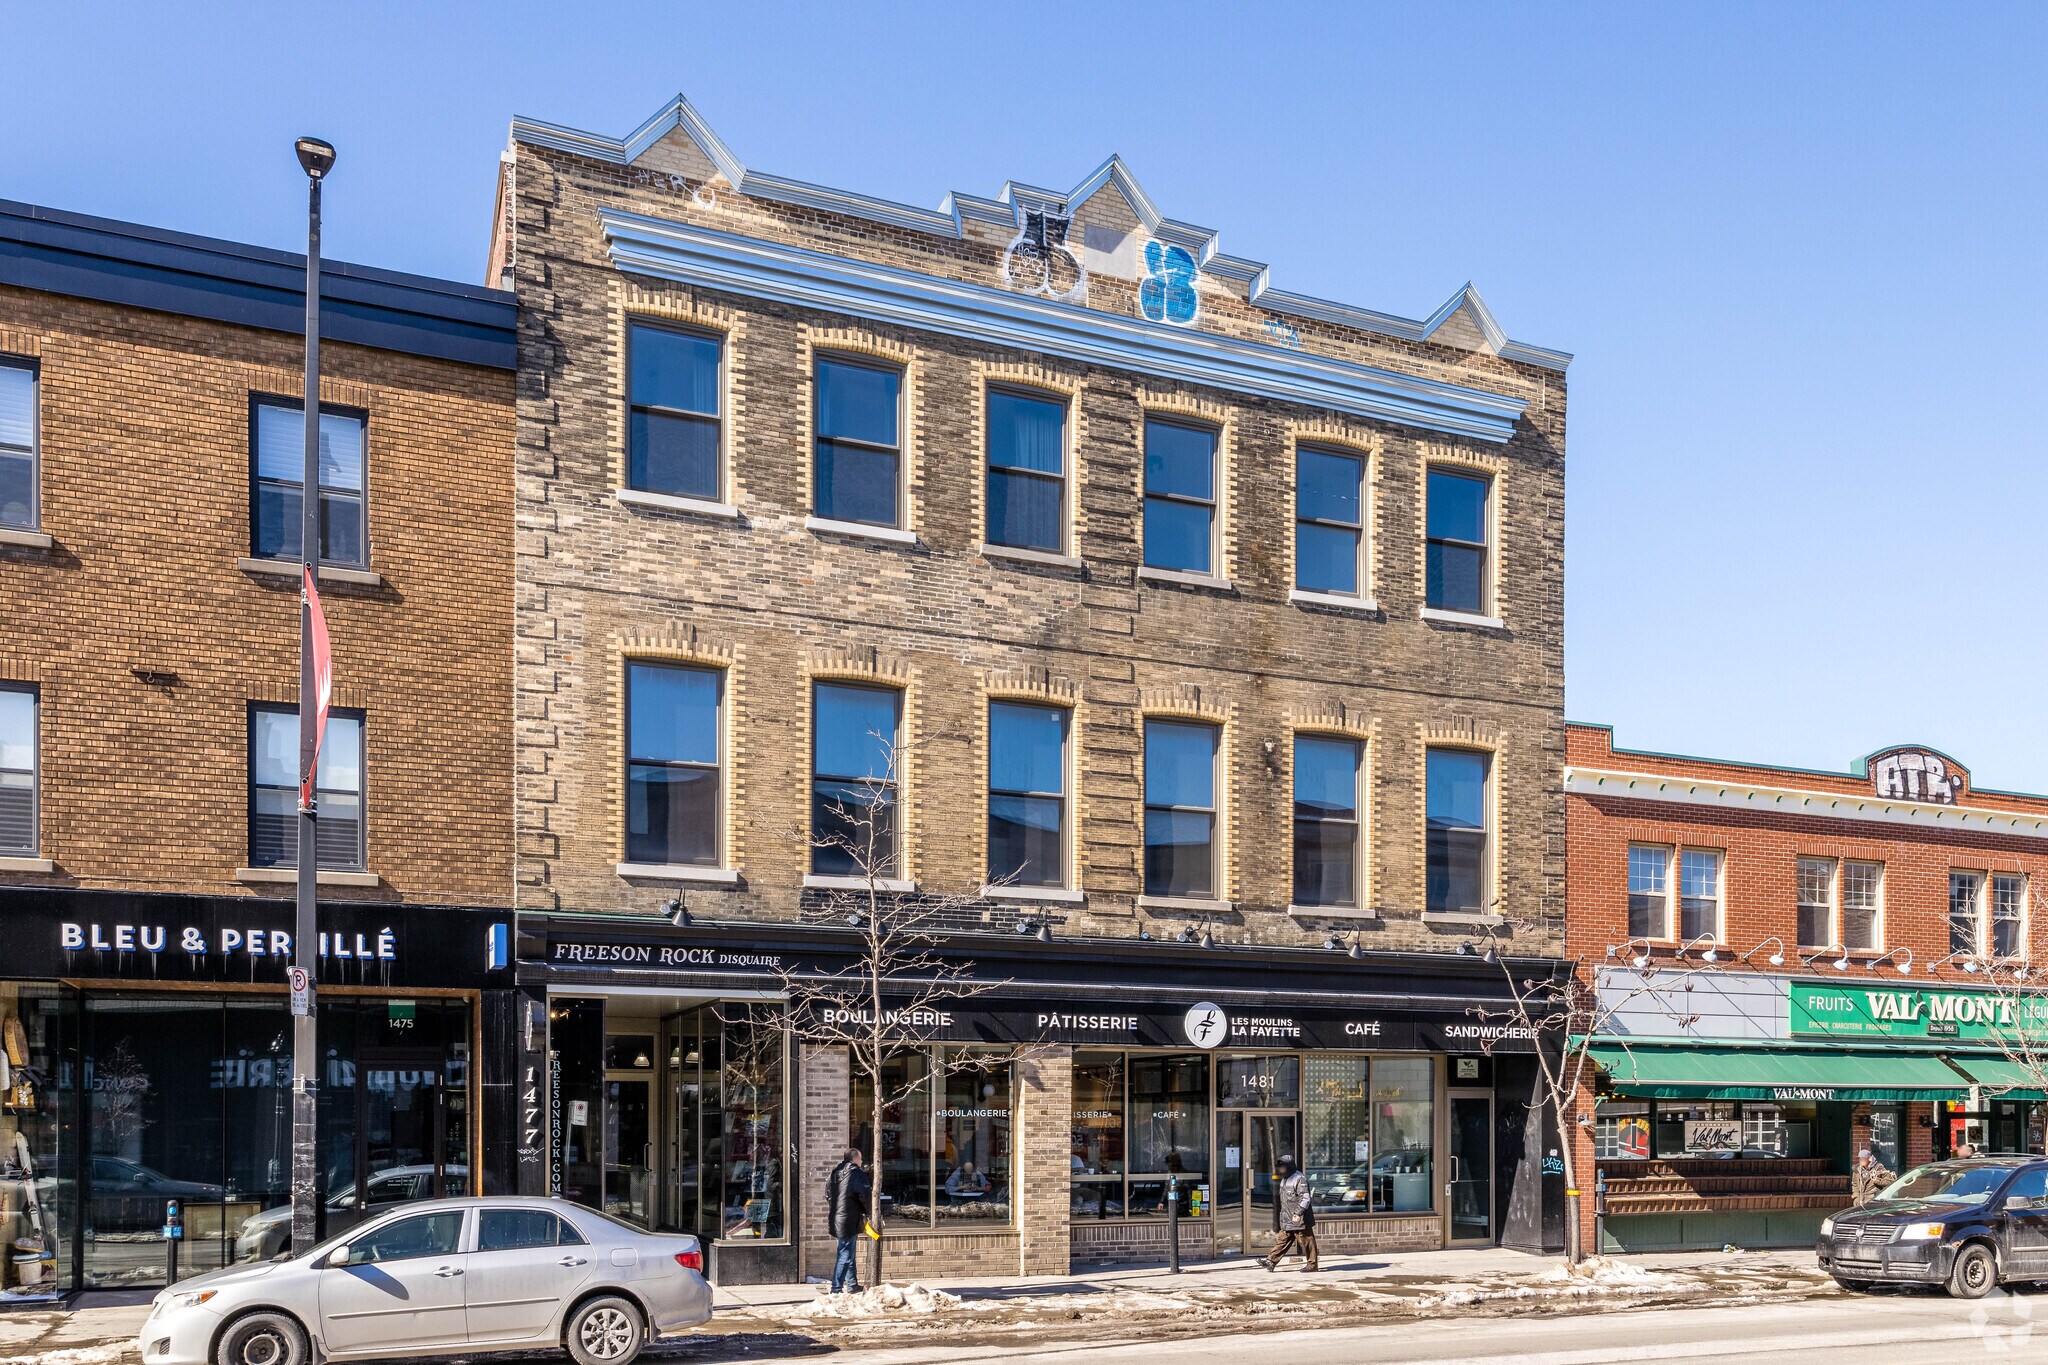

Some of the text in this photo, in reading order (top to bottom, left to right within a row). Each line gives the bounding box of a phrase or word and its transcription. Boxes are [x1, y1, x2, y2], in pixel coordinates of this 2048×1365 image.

[61, 923, 397, 960] BLEU & PERILLÉ
[555, 943, 781, 967] FREESON ROCK DISQUAIRE
[1808, 995, 1854, 1012] FRUITS
[1929, 995, 2017, 1024] MONT
[389, 1018, 414, 1029] 1475
[1038, 1012, 1138, 1031] PÂTISSERIE
[1231, 1018, 1293, 1027] LES MOULINS
[1345, 1021, 1380, 1036] CAFÉ
[1231, 1026, 1301, 1037] LA FAYETTE
[1241, 1075, 1275, 1088] 1481
[523, 1066, 538, 1144] 1477
[941, 1109, 1007, 1118] BOULANGERIE
[1157, 1110, 1179, 1119] CAFÉ
